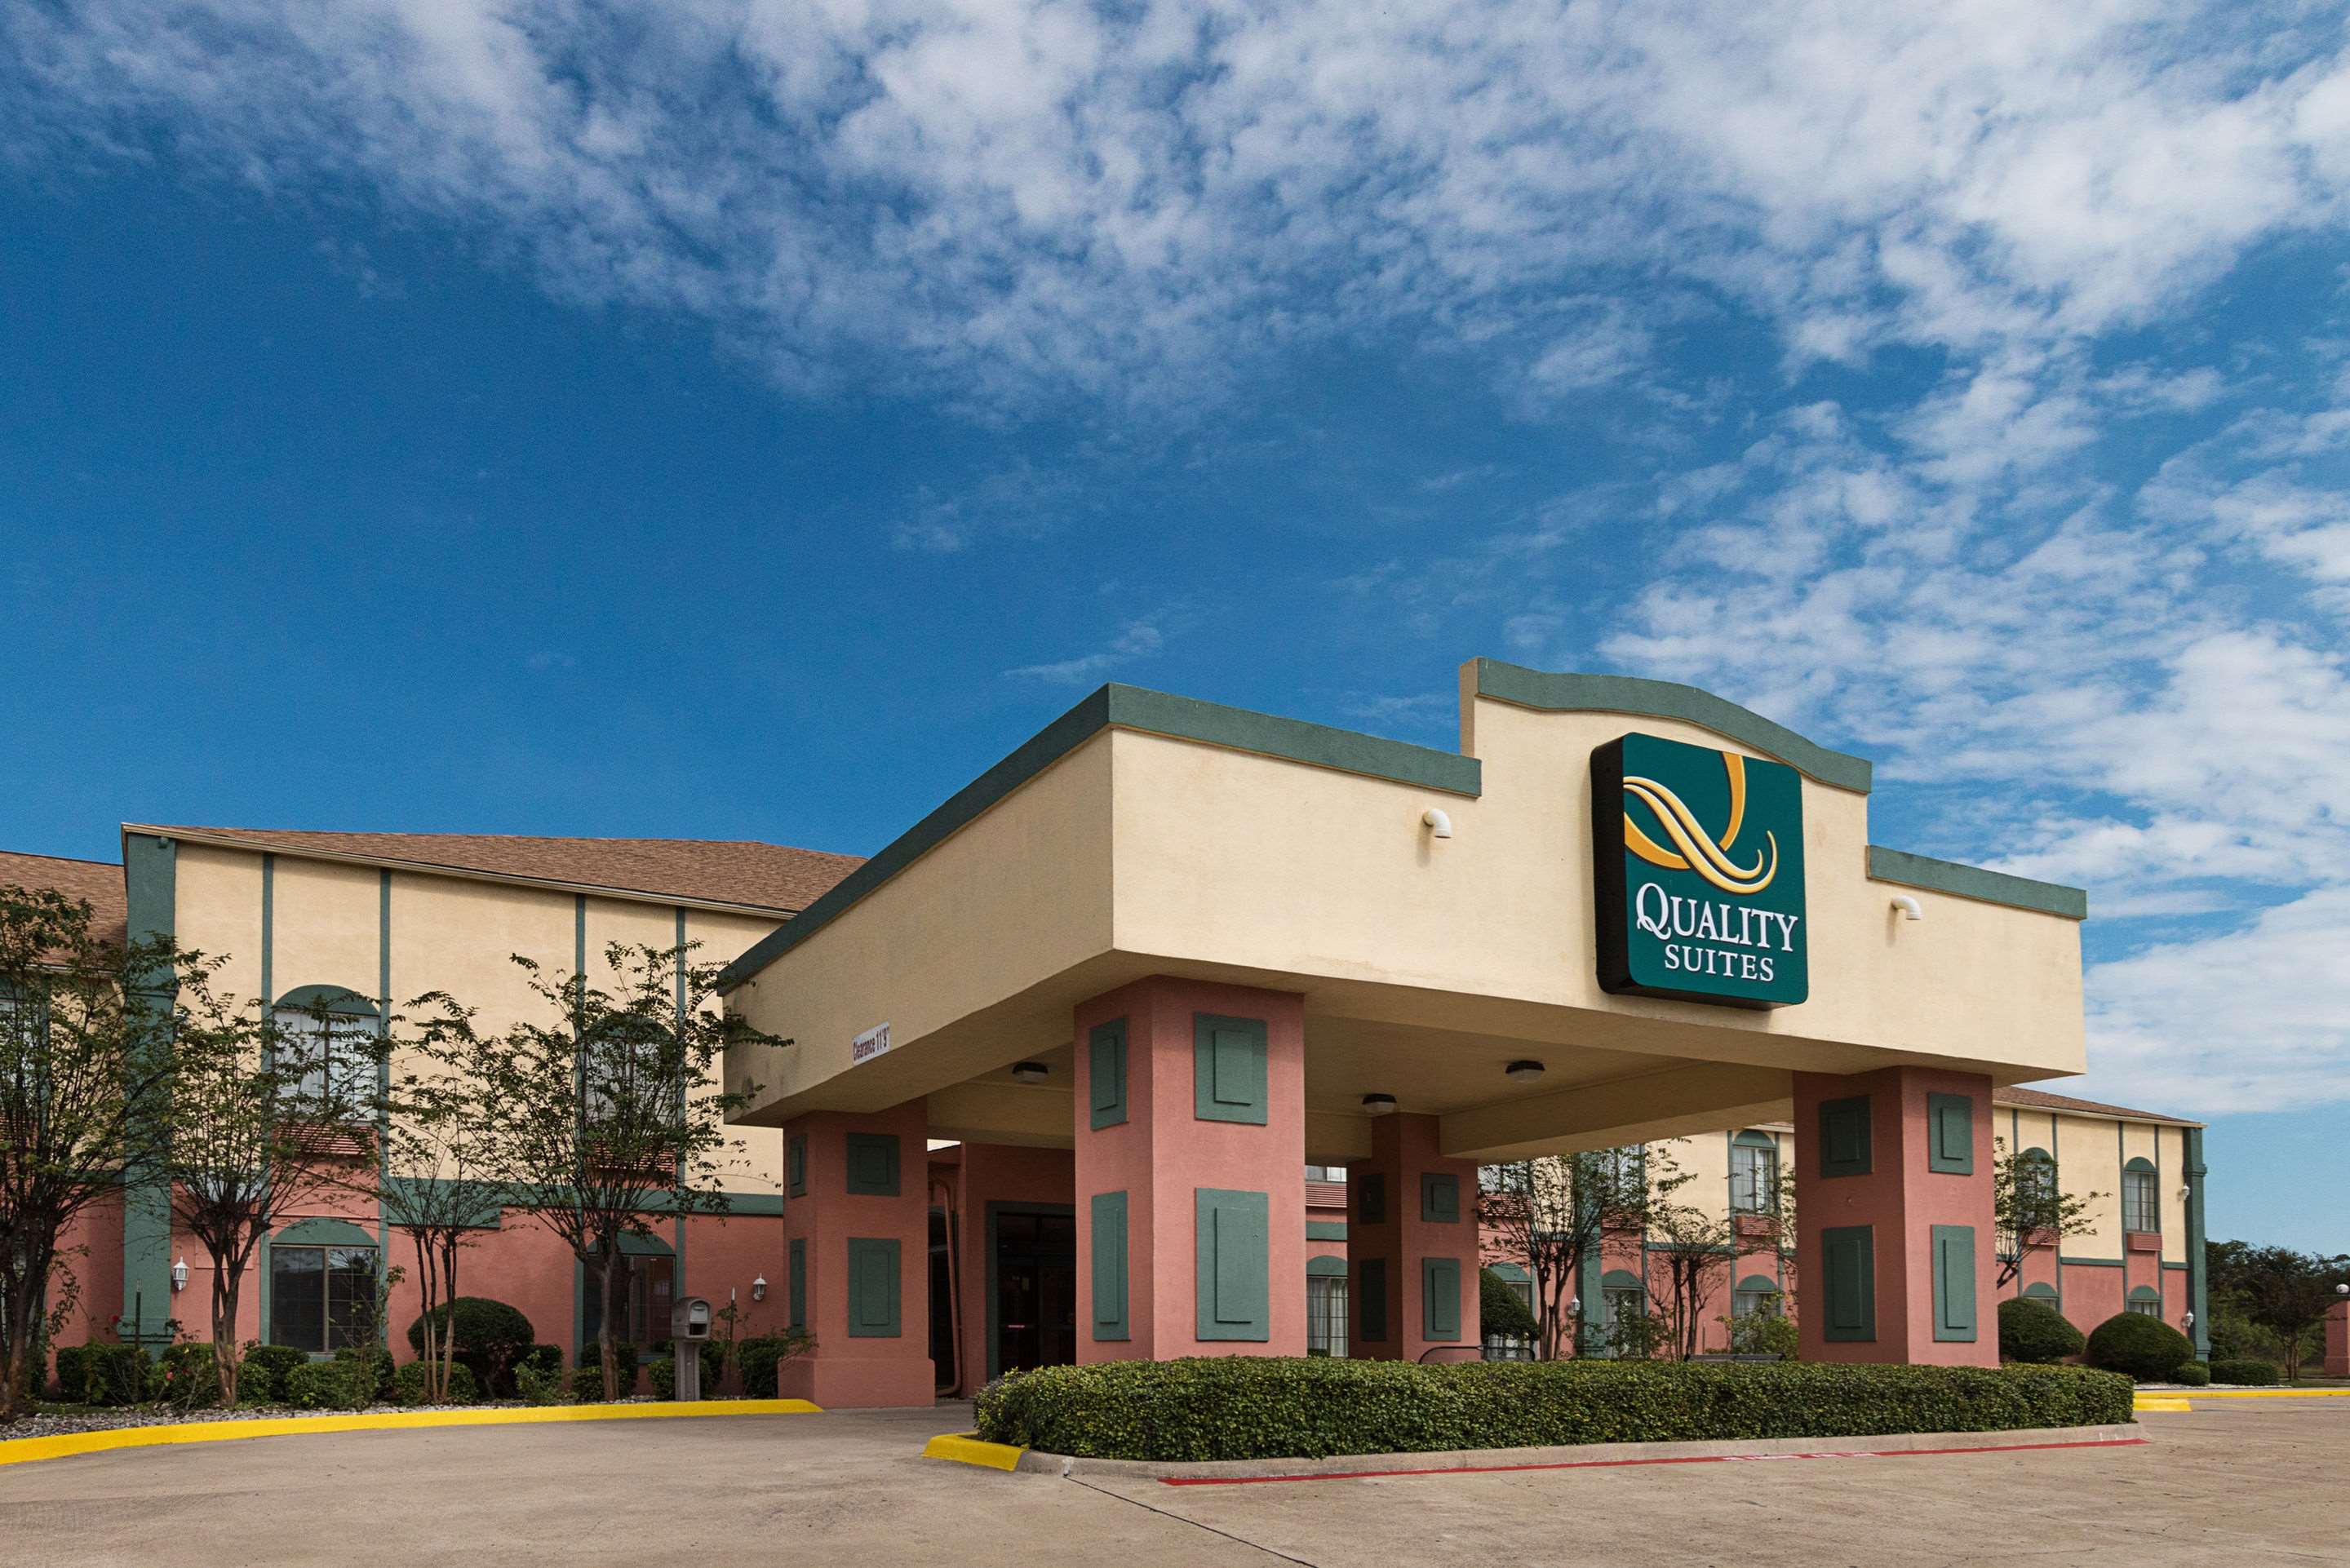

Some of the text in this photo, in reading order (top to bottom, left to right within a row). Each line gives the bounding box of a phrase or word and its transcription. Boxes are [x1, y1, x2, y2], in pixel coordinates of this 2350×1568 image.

[1636, 882, 1798, 952] QUALITY
[1665, 944, 1774, 981] SUITES
[853, 1037, 876, 1061] Clearance
